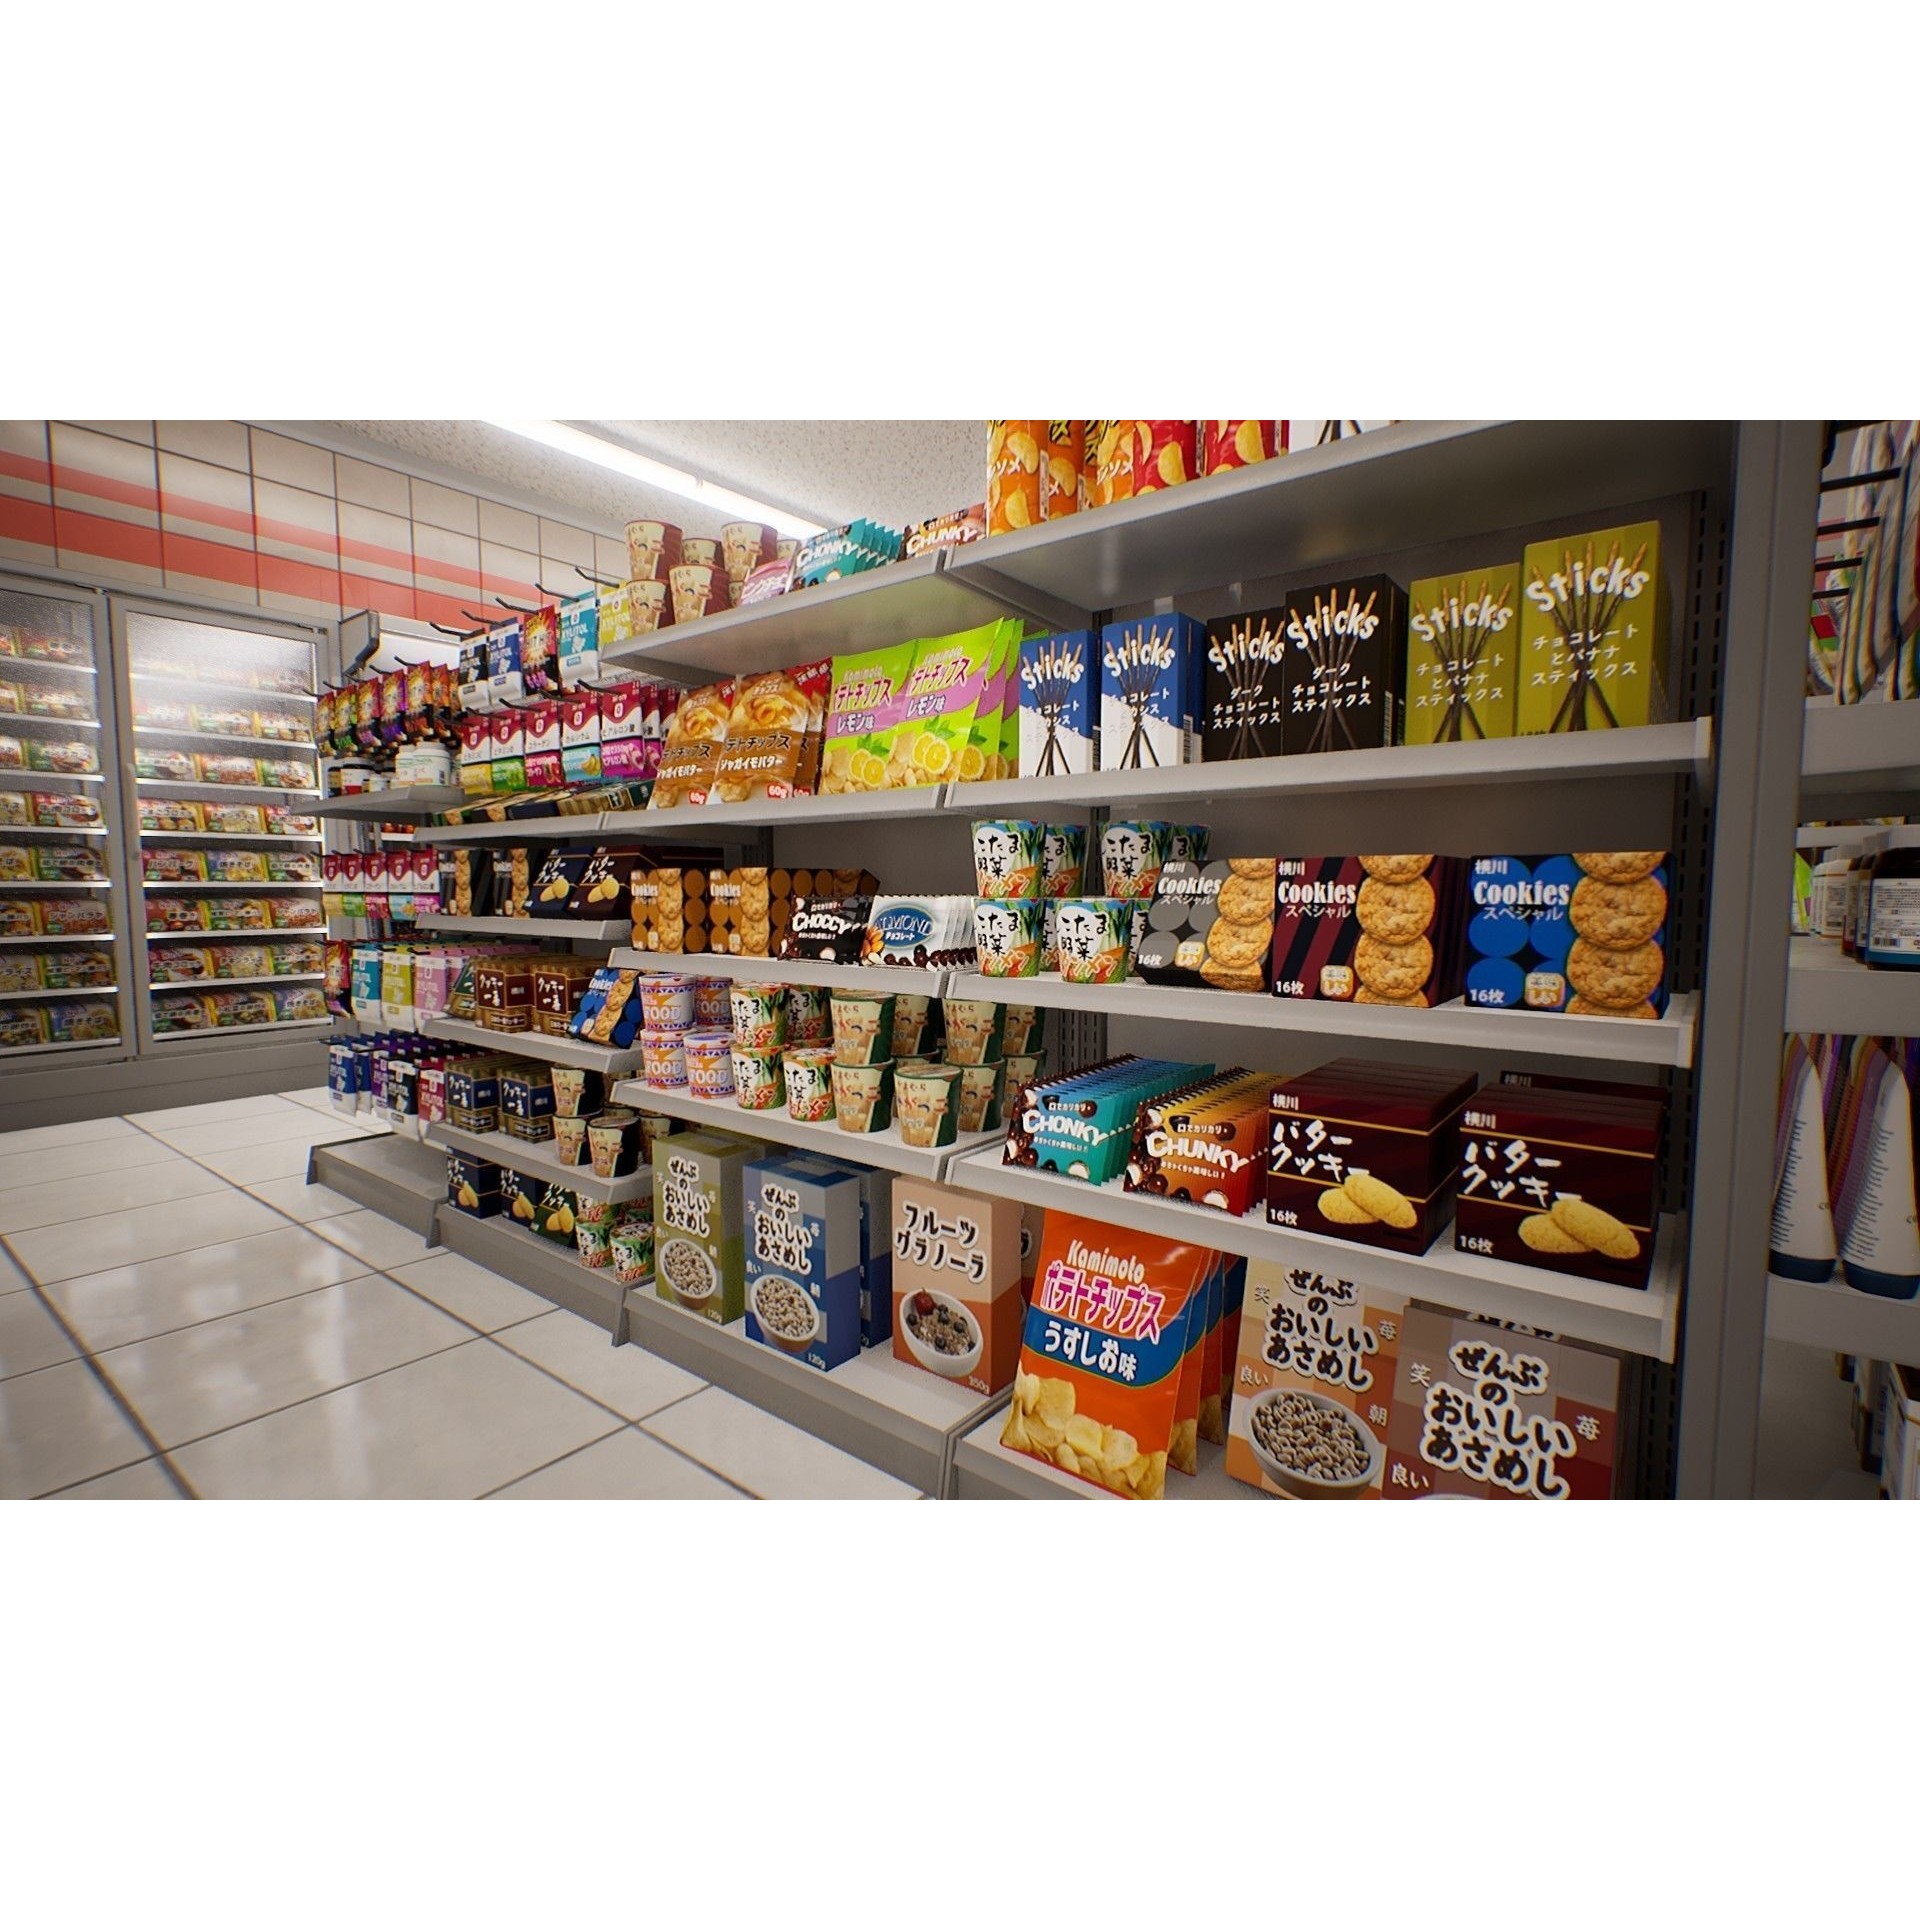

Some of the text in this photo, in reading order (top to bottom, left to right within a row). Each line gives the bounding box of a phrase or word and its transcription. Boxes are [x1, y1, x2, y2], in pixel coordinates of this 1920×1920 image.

[906, 525, 977, 556] CHUNKY
[1526, 557, 1650, 612] Sticks
[1287, 602, 1380, 650] Sticks
[1411, 594, 1514, 642] Sticks
[1532, 624, 1639, 650] チョコレート
[1104, 637, 1176, 677] Sticks
[1208, 630, 1285, 673] Sticks
[1415, 653, 1504, 676] チョコレート
[1552, 647, 1620, 666] とバナナ
[1021, 652, 1085, 690] Sticks
[1312, 662, 1350, 680] ダーク
[1531, 661, 1638, 687] スティックス
[1230, 684, 1263, 700] ダーク
[1292, 675, 1371, 697] チョコレート
[1415, 687, 1504, 708] スティックス
[906, 695, 947, 717] レモン味
[1212, 696, 1280, 716] チョコレート
[1291, 692, 1372, 714] スティックス
[1212, 712, 1281, 730] スティックス
[1158, 877, 1221, 895] Cookies
[1278, 881, 1356, 904] Cookies
[1474, 880, 1571, 906] Cookies
[792, 911, 851, 935] CHOCCY
[1285, 904, 1351, 918] スペシャル
[1483, 906, 1564, 922] スペシャル
[1276, 980, 1304, 995] 16枚
[1470, 988, 1505, 1004] 16枚
[1022, 1109, 1109, 1147] CHONKY
[1272, 1119, 1353, 1152] バター
[1147, 1131, 1250, 1173] CHUNKY
[1270, 1145, 1371, 1183] クッキー
[1463, 1138, 1562, 1174] バター
[1461, 1163, 1583, 1209] クッキー
[905, 1204, 977, 1245] フルーツ
[1270, 1207, 1298, 1226] 16枚
[896, 1230, 985, 1279] グラノーラ
[1459, 1234, 1494, 1254] 16枚
[1067, 1239, 1146, 1284] Kamimoto
[1287, 1267, 1356, 1302] ぜんぶ
[1040, 1259, 1166, 1346] ポテトチップス
[1307, 1297, 1329, 1316] の
[1269, 1304, 1375, 1352] おいしい
[1043, 1319, 1138, 1382] うすしお味
[1266, 1333, 1370, 1387] あさめし
[1455, 1344, 1542, 1389] ぜんぶ
[1481, 1382, 1508, 1407] の
[1430, 1388, 1569, 1454] おいしい
[1426, 1424, 1564, 1499] あさめし
[1391, 1462, 1430, 1489] 良い
